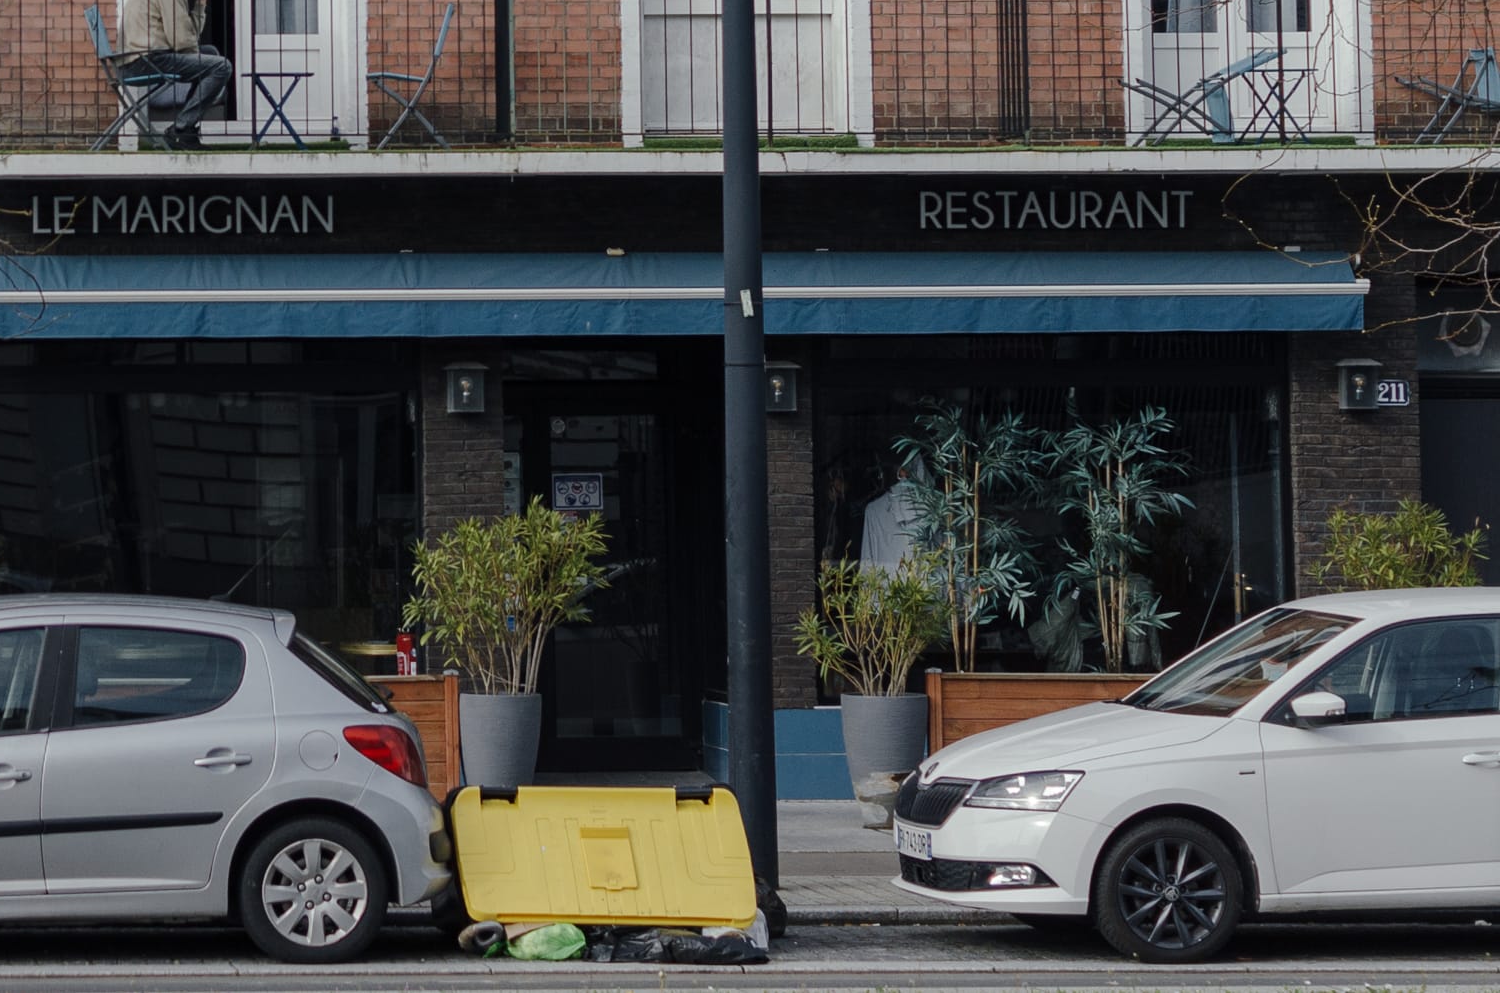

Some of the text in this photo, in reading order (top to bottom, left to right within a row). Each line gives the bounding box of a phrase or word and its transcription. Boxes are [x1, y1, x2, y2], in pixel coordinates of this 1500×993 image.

[32, 194, 335, 235] LE MARIGNAN
[919, 190, 1194, 230] RESTAURANT
[1377, 381, 1407, 403] 211
